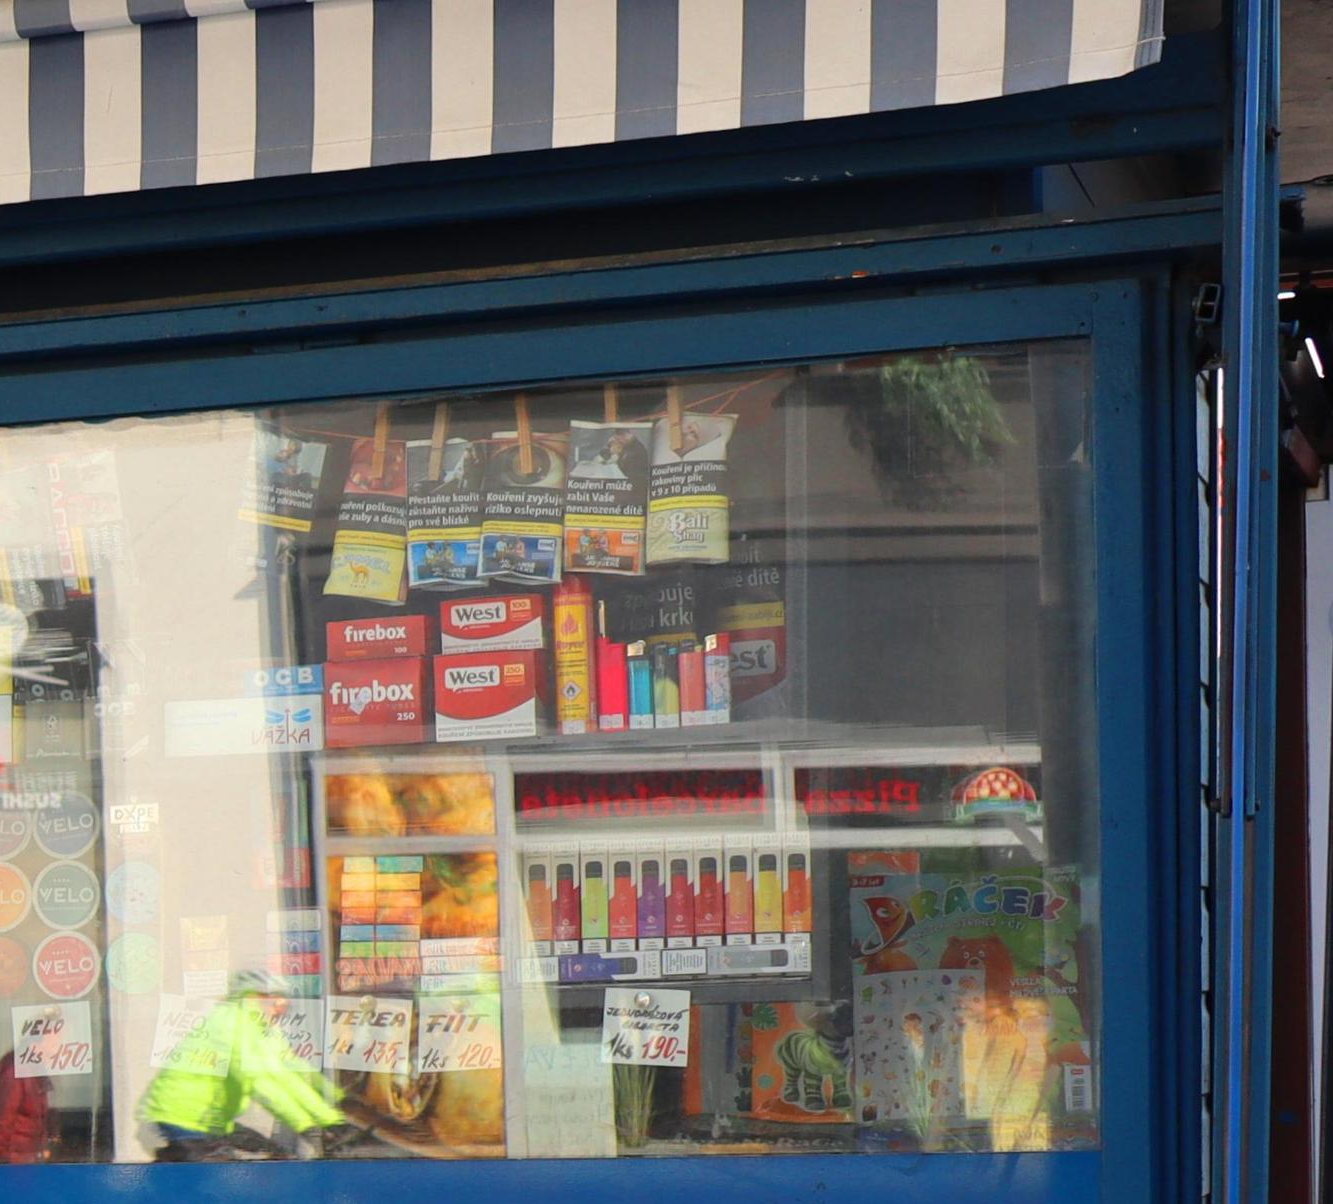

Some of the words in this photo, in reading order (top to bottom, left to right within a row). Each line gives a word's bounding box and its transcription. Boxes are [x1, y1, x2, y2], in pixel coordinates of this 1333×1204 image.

[454, 604, 502, 622] West
[344, 624, 406, 643] firebox
[449, 670, 496, 686] West
[396, 712, 415, 721] 250
[39, 886, 94, 904] VELO
[39, 956, 94, 976] VELO
[331, 1008, 407, 1027] TEREA
[21, 1019, 65, 1036] VELO
[19, 1046, 43, 1065] 1ks
[608, 1033, 634, 1060] 1ks
[421, 1047, 447, 1070] 1ks
